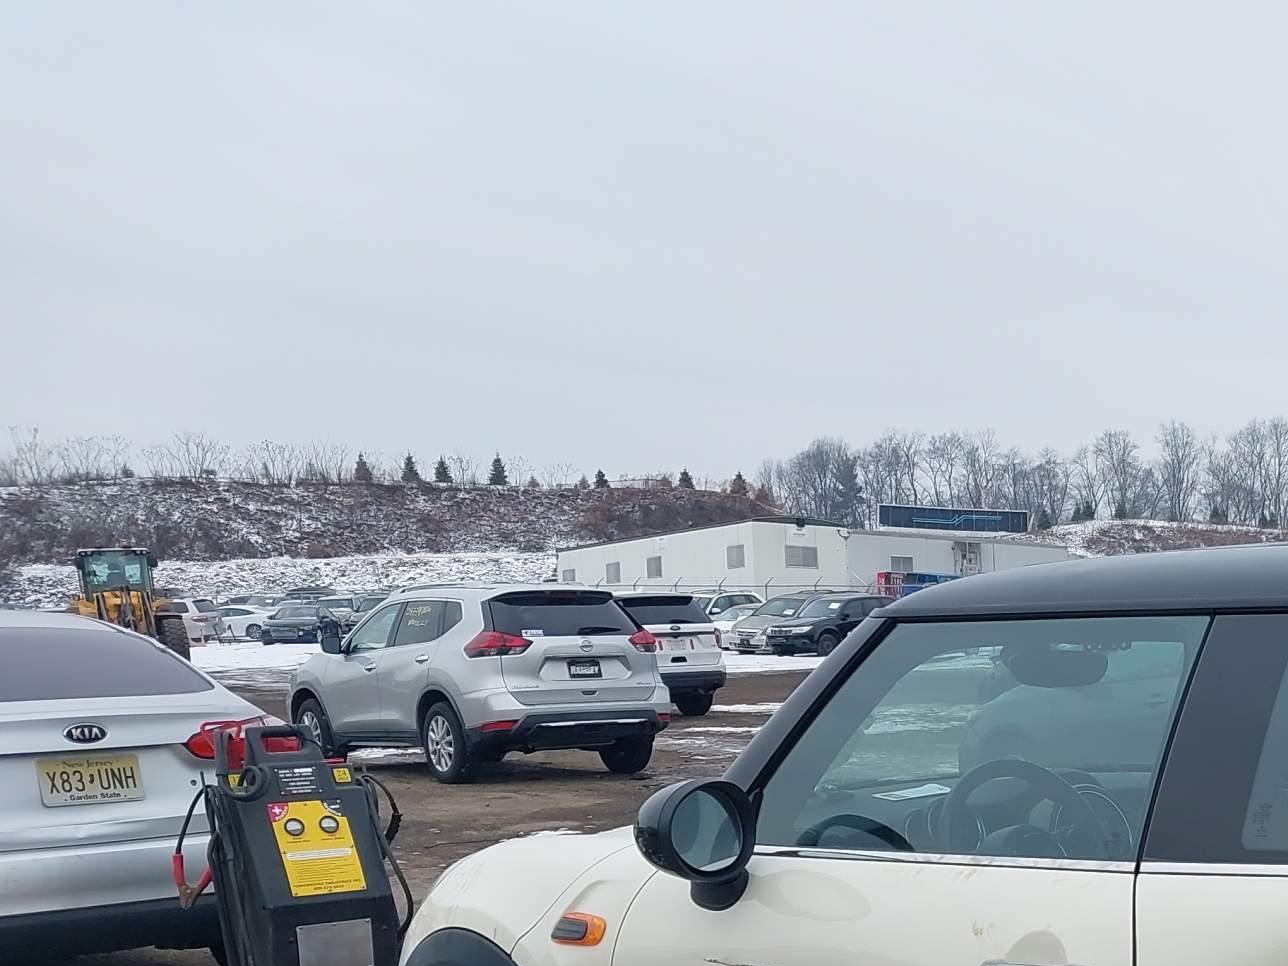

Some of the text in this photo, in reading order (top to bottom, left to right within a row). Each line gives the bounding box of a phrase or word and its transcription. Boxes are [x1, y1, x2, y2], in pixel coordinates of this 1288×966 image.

[71, 728, 102, 740] KIA
[46, 767, 137, 794] X83 UNH
